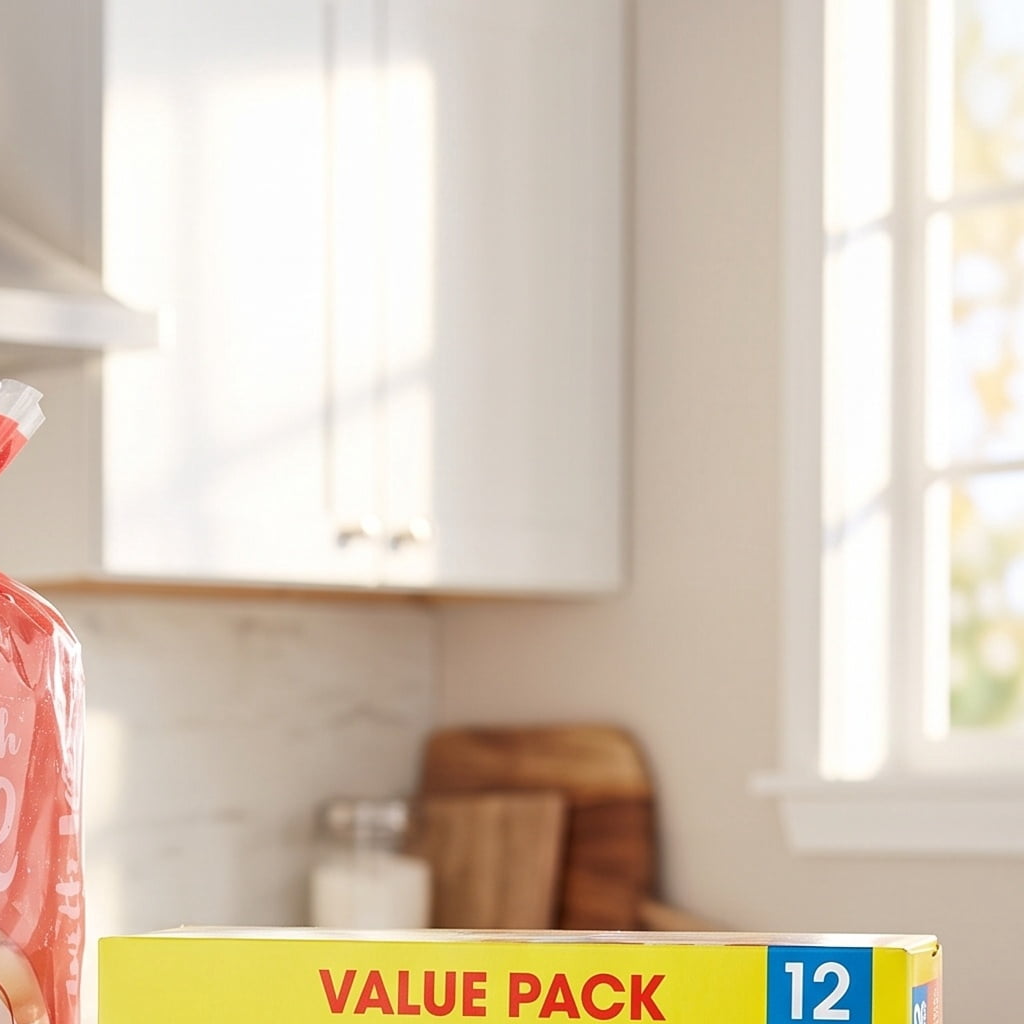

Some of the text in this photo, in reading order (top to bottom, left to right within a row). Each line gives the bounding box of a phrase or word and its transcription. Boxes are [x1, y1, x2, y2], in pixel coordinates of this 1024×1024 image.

[319, 969, 667, 1022] VALUE PACK
[784, 961, 851, 1021] 12
